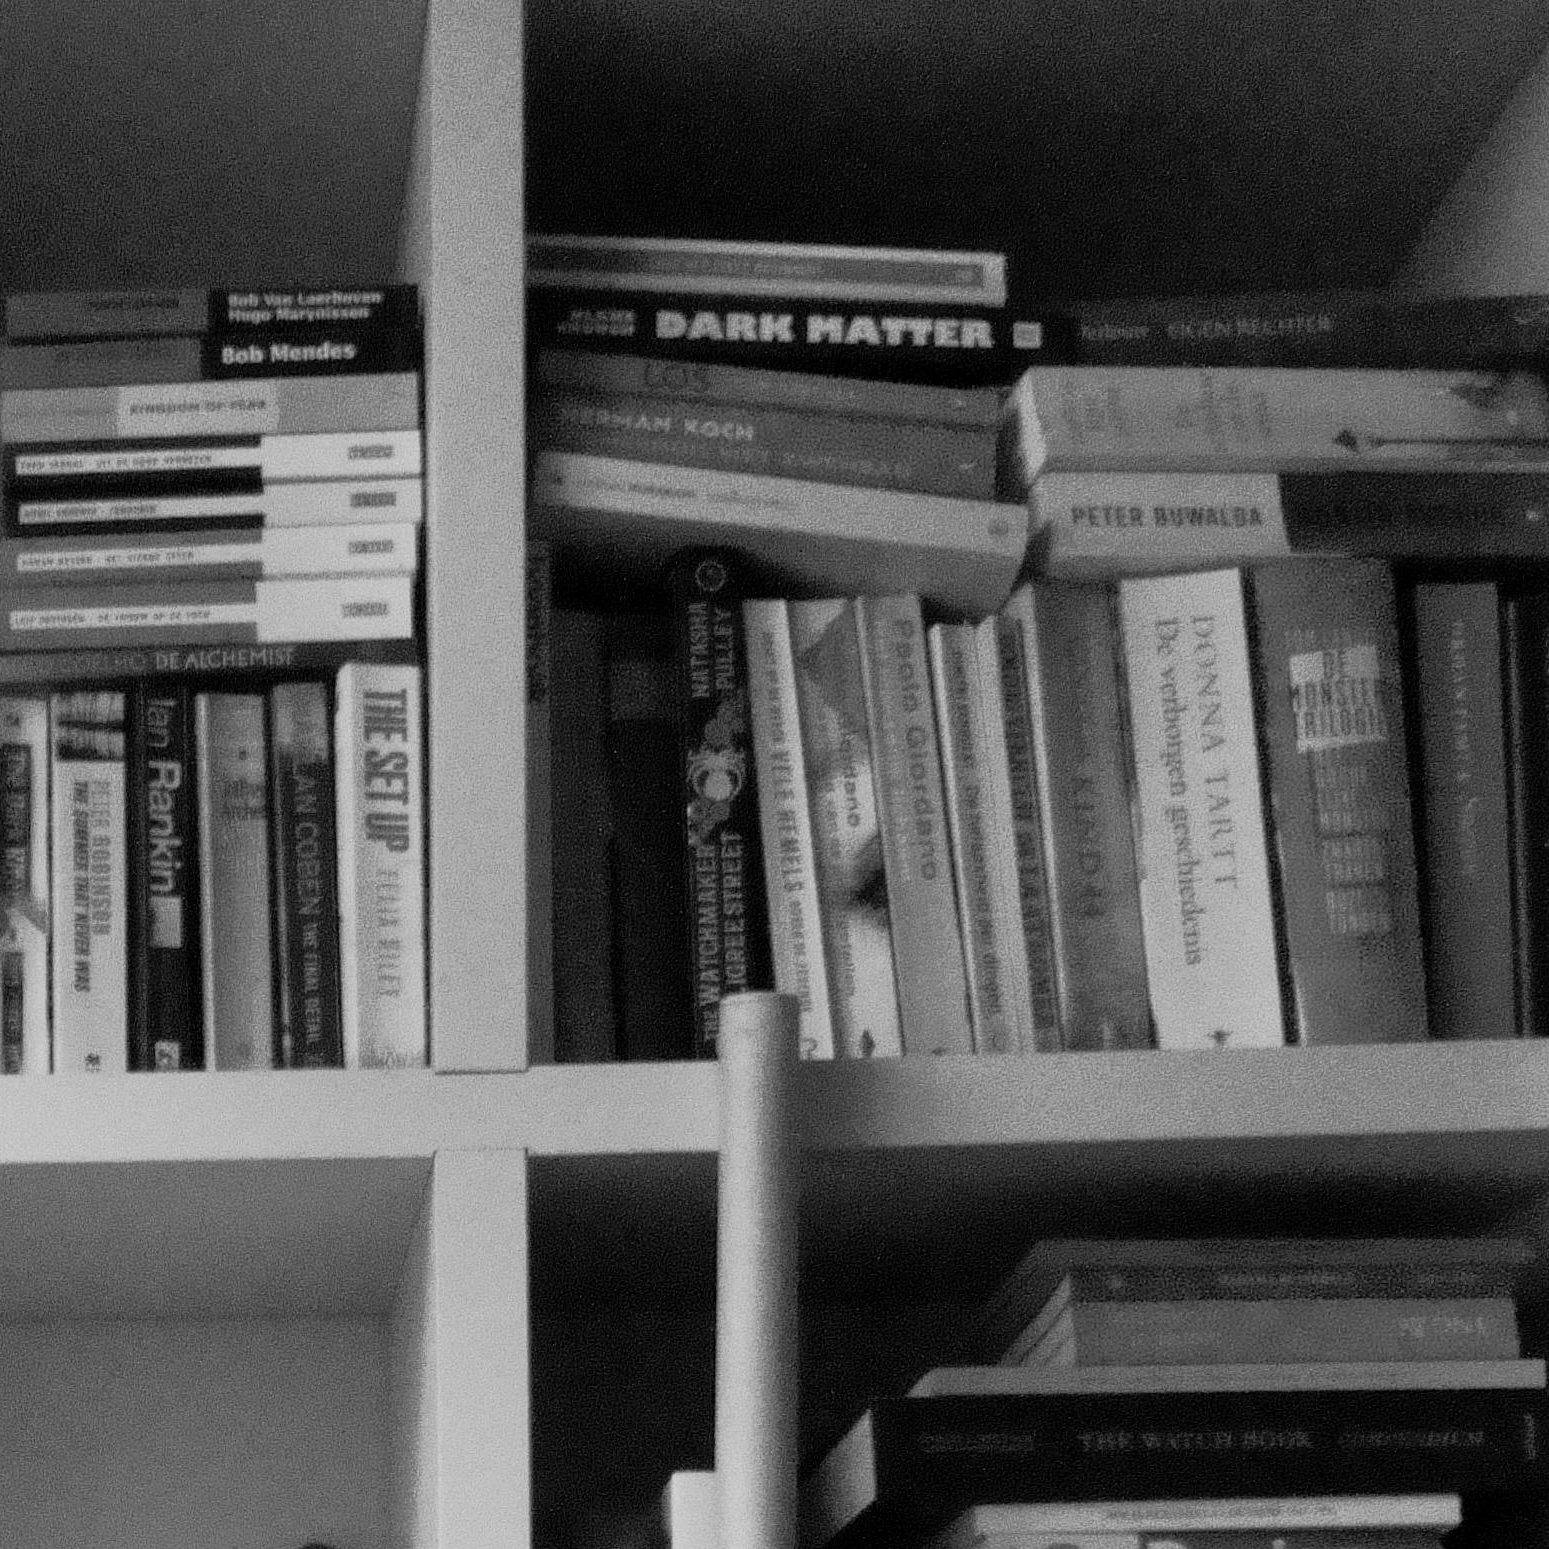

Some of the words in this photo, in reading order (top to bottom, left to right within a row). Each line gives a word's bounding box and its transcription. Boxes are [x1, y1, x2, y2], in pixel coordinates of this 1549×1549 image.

[221, 345, 265, 365] Bob
[269, 340, 357, 363] Mendes
[655, 308, 795, 342] DARK
[805, 312, 995, 349] MATTER
[682, 418, 756, 444] KOCH
[1070, 506, 1144, 528] PETER
[1153, 505, 1263, 529] BUWALDA
[155, 654, 181, 671] DE
[183, 647, 295, 670] ALCHEMIST
[688, 601, 712, 699] NATASHA
[714, 606, 737, 691] PULLEY
[1152, 616, 1186, 658] De
[1188, 613, 1228, 757] DONNA
[148, 700, 179, 749] Ian
[363, 689, 409, 743] THE
[1160, 666, 1195, 799] verborgen
[363, 749, 410, 806] SET
[770, 751, 794, 801] VELE
[895, 619, 916, 714] Paolo
[906, 724, 939, 881] Giordano
[74, 810, 91, 870] SUMMER
[148, 760, 183, 898] Rankin
[363, 810, 411, 854] UP
[1069, 774, 1107, 878] KIND
[1202, 768, 1240, 891] TARTT
[74, 875, 91, 910] THAT
[92, 835, 112, 937] ROBINSON
[295, 821, 322, 916] COBEN
[721, 830, 748, 921] STREET
[1162, 804, 1209, 967] geschiedenis
[74, 912, 91, 956] NEVER
[695, 843, 723, 1005] WATCHMAKER
[74, 959, 91, 992] WAS
